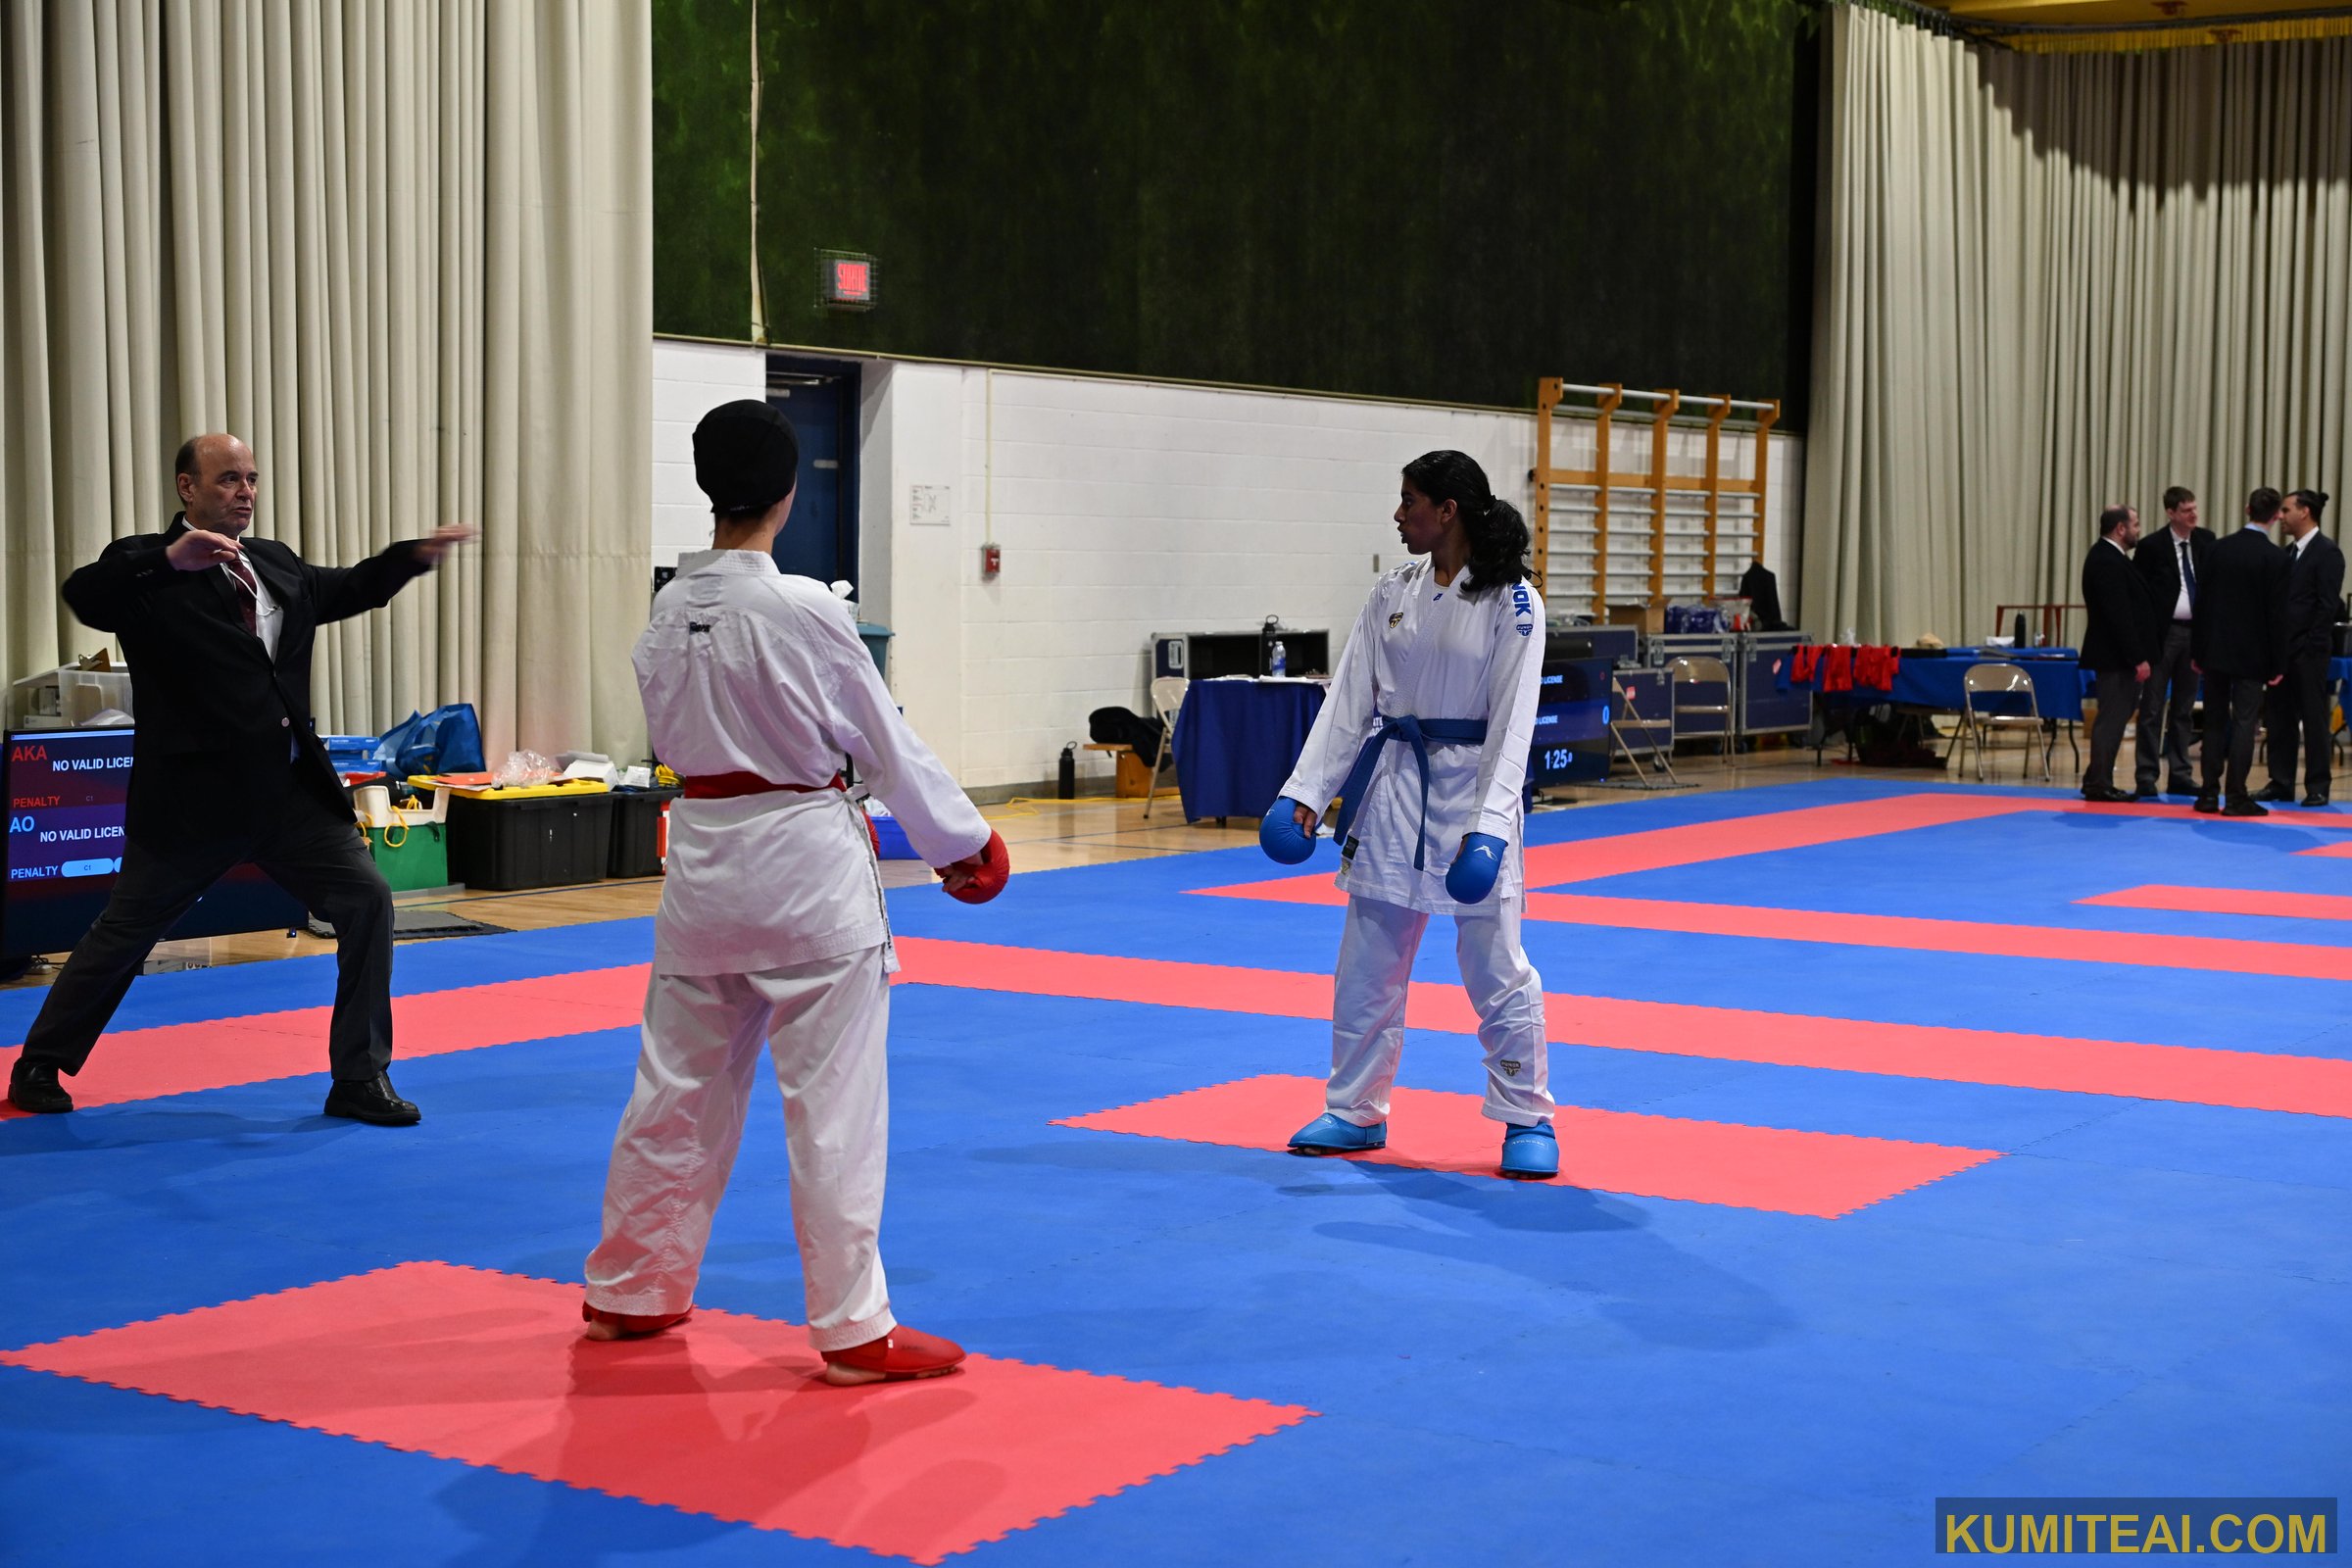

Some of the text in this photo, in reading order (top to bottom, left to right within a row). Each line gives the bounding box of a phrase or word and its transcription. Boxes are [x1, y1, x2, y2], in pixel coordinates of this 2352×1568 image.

[12, 745, 47, 762] AKA
[52, 760, 70, 772] NO
[72, 758, 104, 770] VALID
[13, 796, 61, 808] PENALTY
[9, 815, 35, 833] AO
[40, 830, 57, 843] NO
[60, 828, 92, 841] VALID
[11, 865, 59, 879] PENALTY
